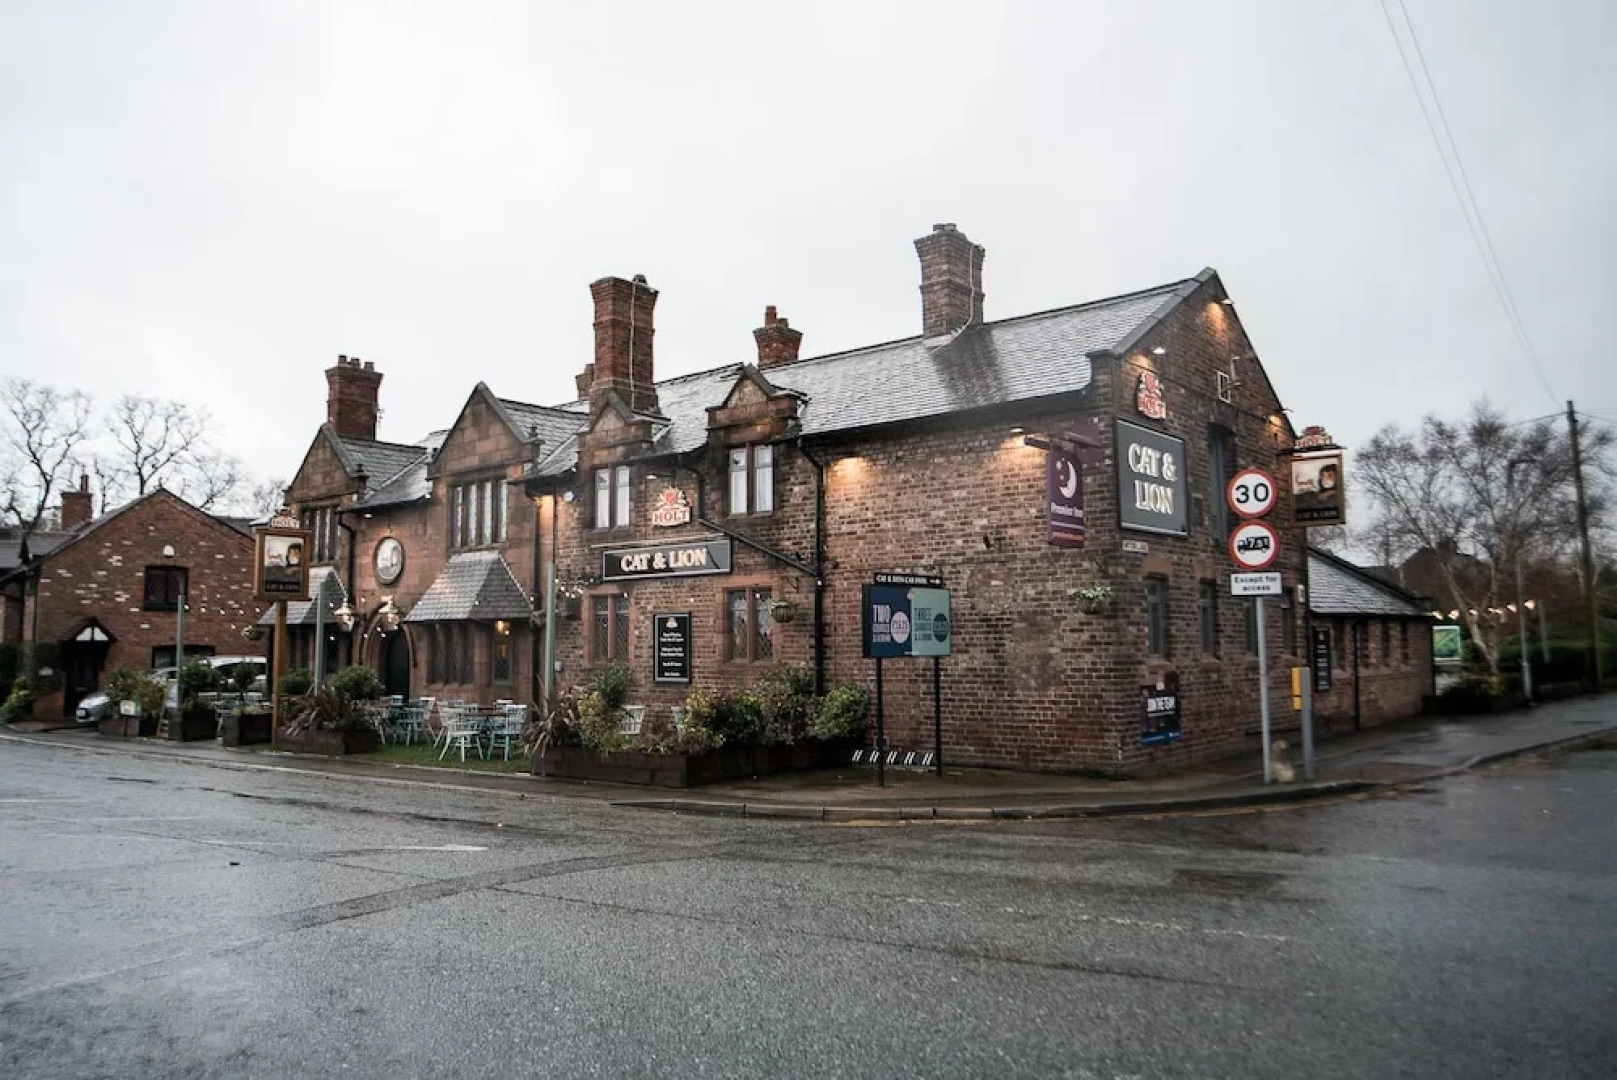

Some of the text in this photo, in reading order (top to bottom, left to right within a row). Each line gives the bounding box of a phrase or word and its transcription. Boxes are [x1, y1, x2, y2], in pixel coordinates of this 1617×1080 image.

[1128, 442, 1177, 482] CAT &
[1134, 479, 1175, 514] LION
[1235, 483, 1269, 503] 30
[654, 509, 689, 523] HOLT
[620, 548, 707, 572] CAT & LION
[1234, 575, 1279, 585] Except for
